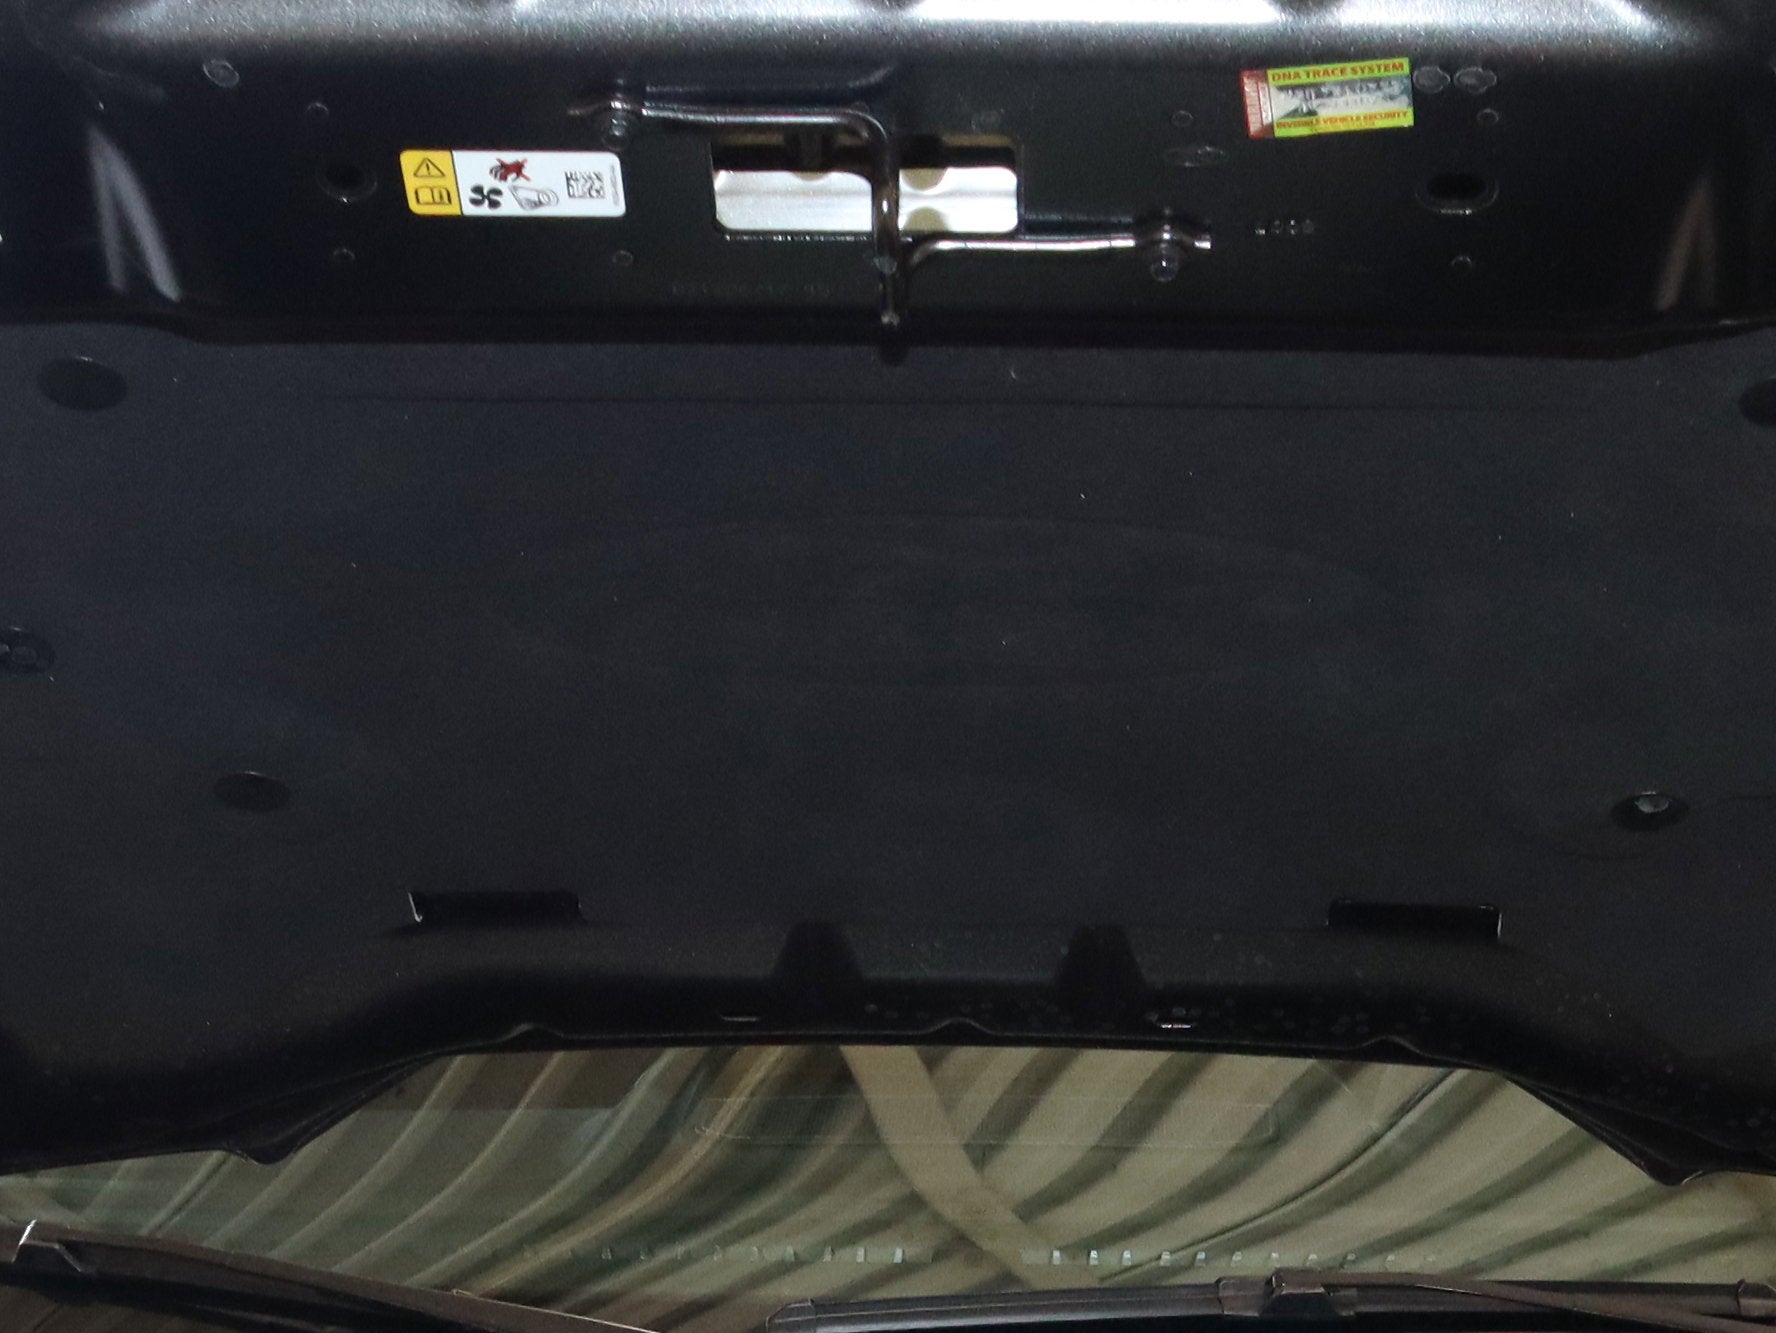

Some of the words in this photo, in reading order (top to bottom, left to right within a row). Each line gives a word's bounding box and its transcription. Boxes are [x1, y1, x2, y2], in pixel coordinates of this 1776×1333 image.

[1272, 69, 1302, 81] DNA
[1305, 66, 1348, 78] TRACE
[1351, 61, 1404, 75] SYSTEM
[1323, 114, 1361, 125] VEHICLE
[1363, 110, 1408, 121] SECURITY
